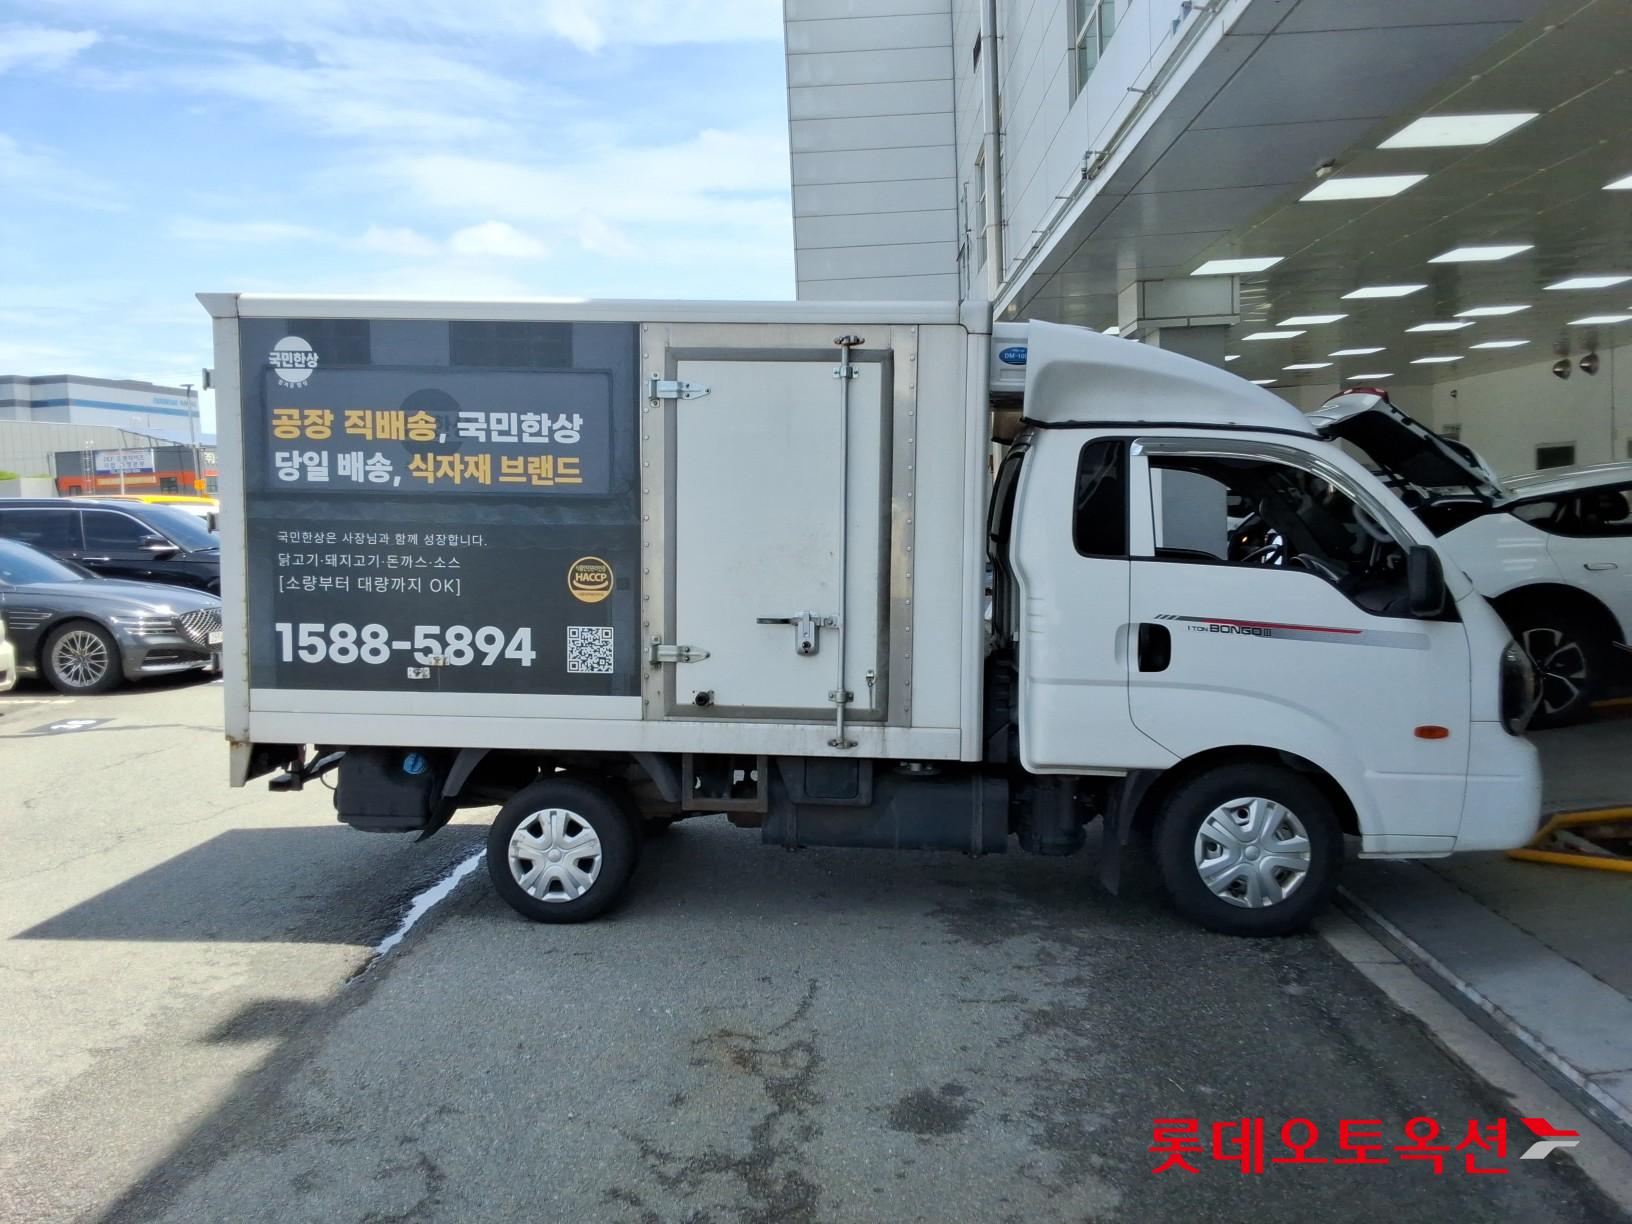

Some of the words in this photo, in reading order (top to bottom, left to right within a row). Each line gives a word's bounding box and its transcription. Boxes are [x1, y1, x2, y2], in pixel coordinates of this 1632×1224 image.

[269, 352, 318, 368] 국민한상
[272, 408, 334, 440] 공장
[344, 409, 447, 444] 직배송,
[457, 411, 583, 444] 국민한상
[275, 450, 329, 482] 당일
[337, 451, 401, 487] 배송,
[407, 453, 492, 484] 식자재
[499, 455, 583, 486] 브랜드
[277, 531, 337, 544] 국민한상은
[342, 532, 389, 545] 사장님과
[394, 533, 418, 546] 함께
[423, 534, 488, 547] 성장합니다.
[279, 575, 350, 593] [소량부터
[357, 576, 422, 593] 대량까지
[430, 578, 461, 596] OK]
[575, 572, 607, 582] HACCP
[275, 623, 536, 666] 1588-5894
